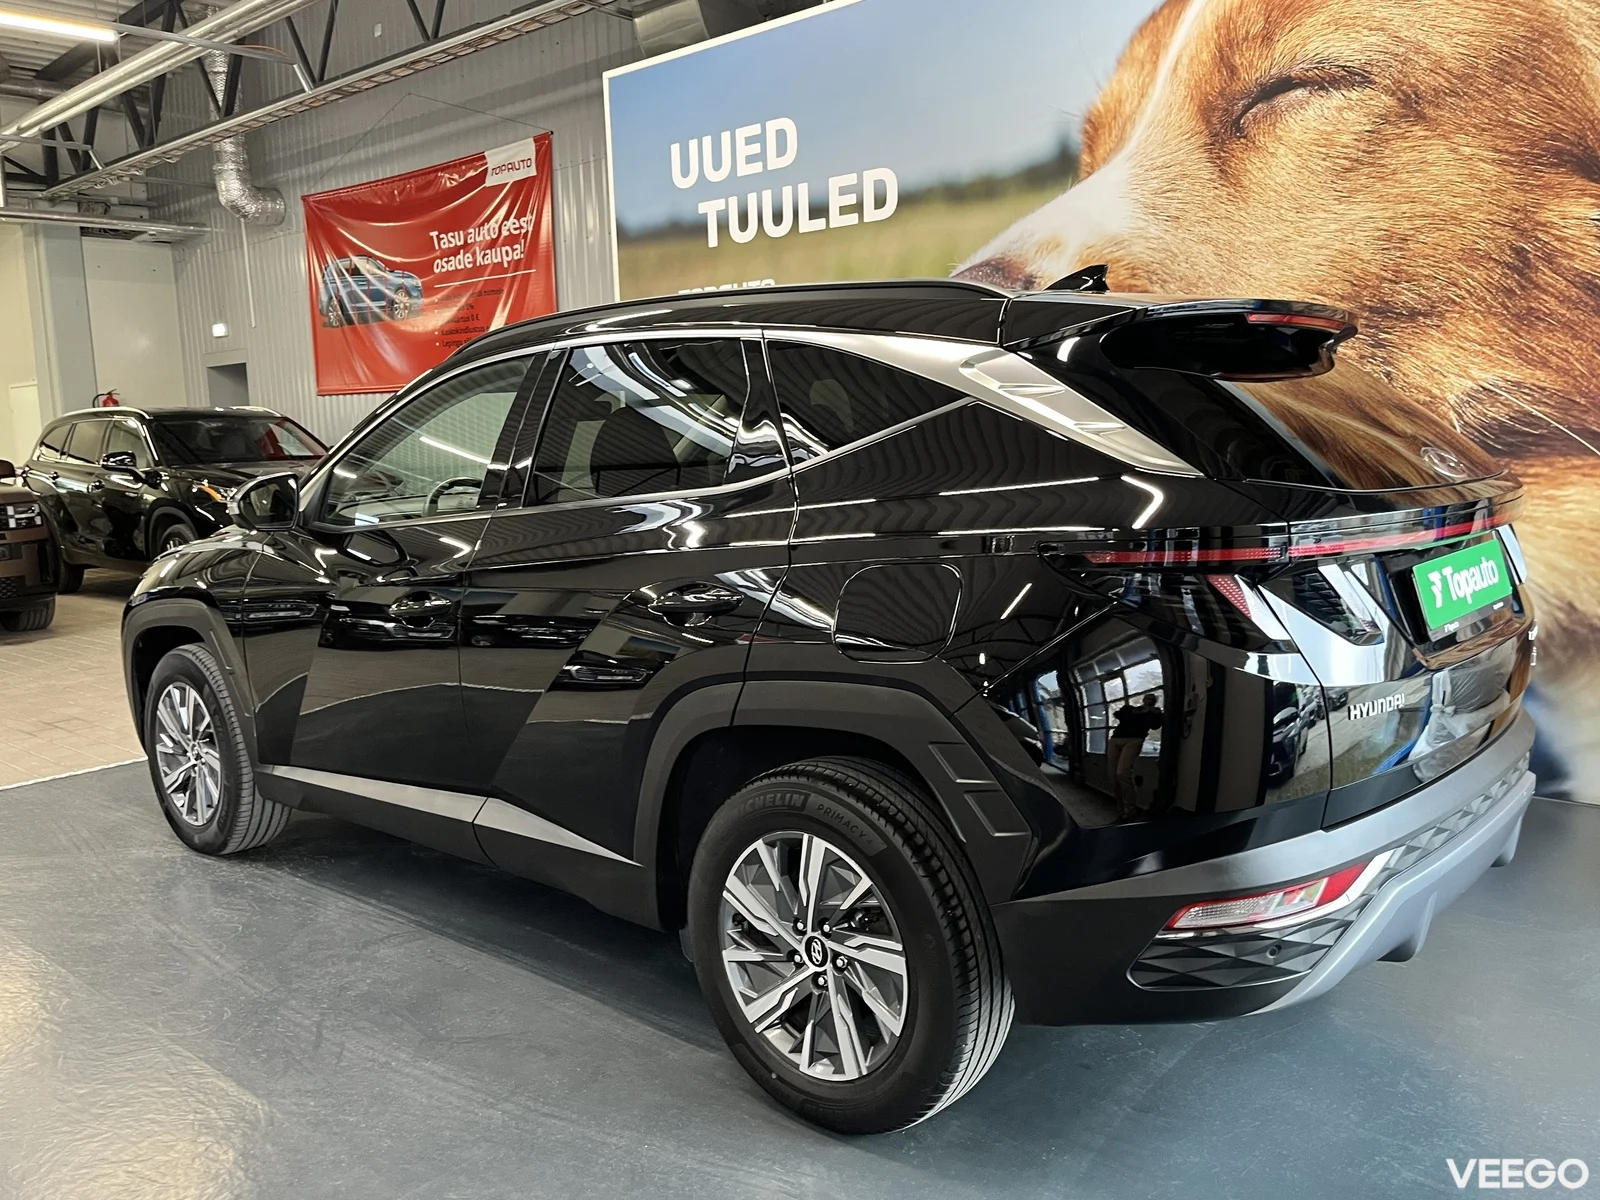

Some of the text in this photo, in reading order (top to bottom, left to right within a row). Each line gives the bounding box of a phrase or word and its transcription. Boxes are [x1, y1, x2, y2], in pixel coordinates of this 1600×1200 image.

[491, 158, 532, 176] TOPAUTO
[671, 117, 797, 189] UUED
[698, 167, 898, 248] TUULED
[429, 230, 464, 250] Tasu
[467, 222, 498, 244] auto
[433, 239, 524, 273] osade kaupa!
[1441, 556, 1499, 604] Topauto
[1349, 693, 1405, 720] HYUNDAI
[816, 803, 867, 838] PRIMACY
